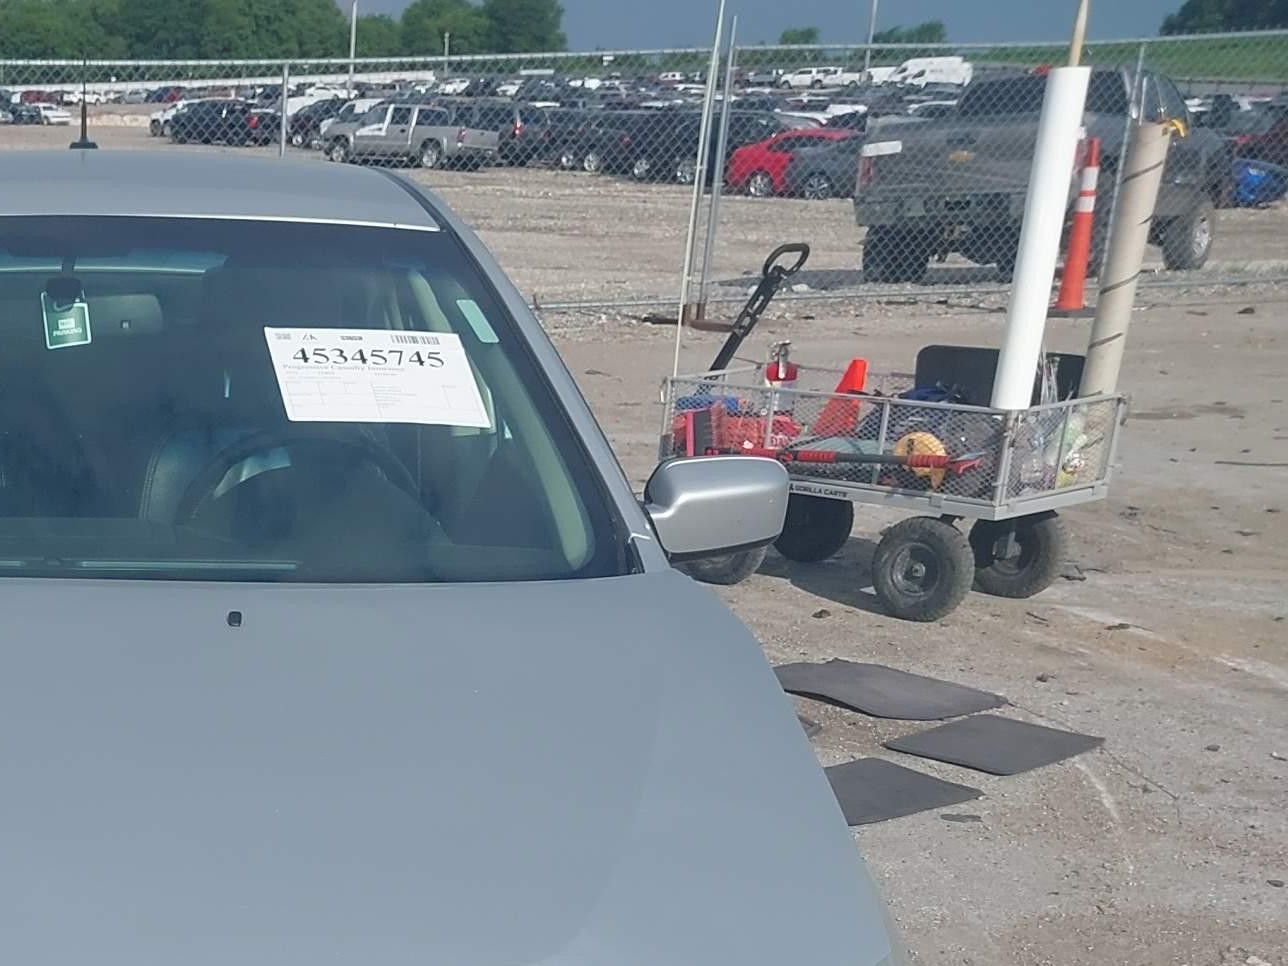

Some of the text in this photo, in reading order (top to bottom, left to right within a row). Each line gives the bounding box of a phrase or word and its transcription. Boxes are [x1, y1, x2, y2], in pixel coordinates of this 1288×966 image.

[293, 347, 445, 368] 45345745
[794, 485, 848, 498] GORILLA CARTS
